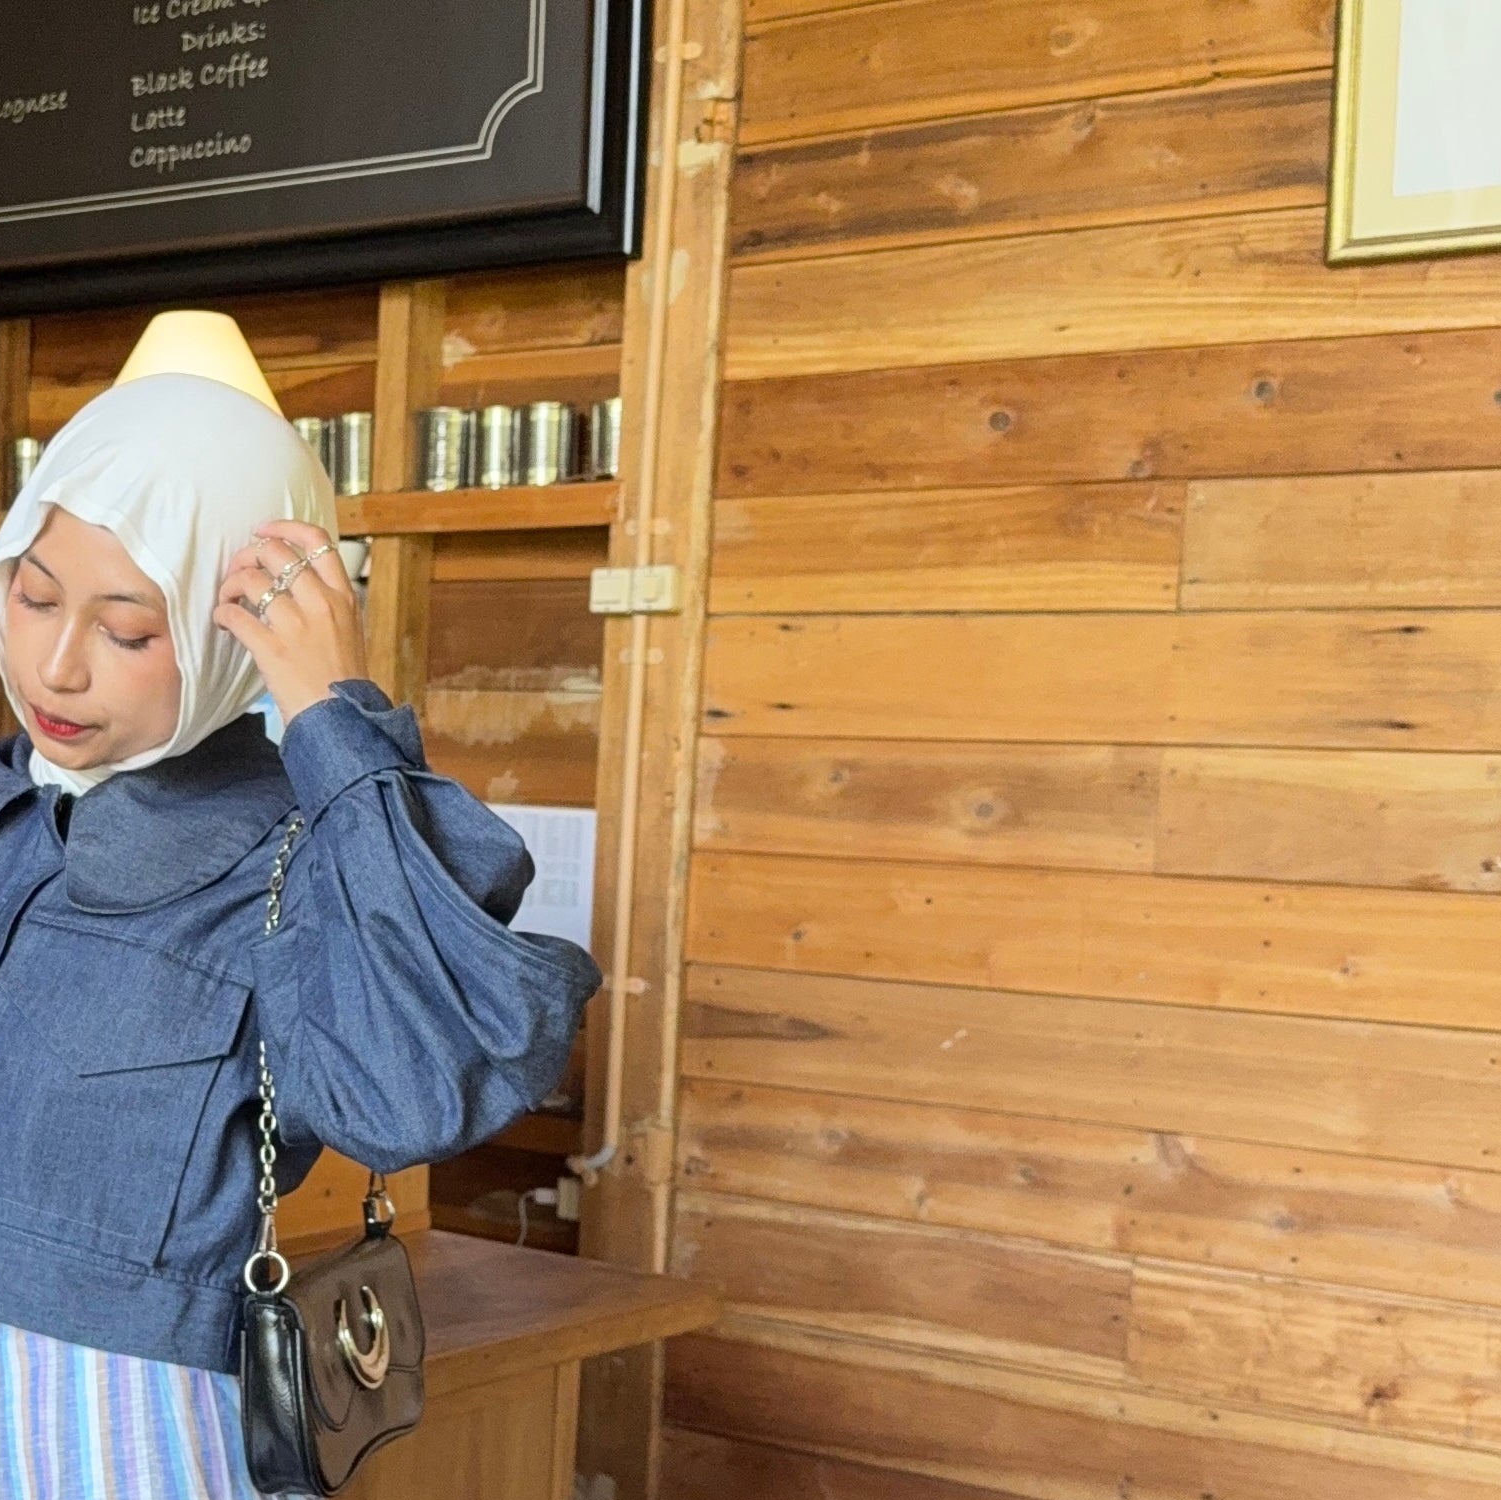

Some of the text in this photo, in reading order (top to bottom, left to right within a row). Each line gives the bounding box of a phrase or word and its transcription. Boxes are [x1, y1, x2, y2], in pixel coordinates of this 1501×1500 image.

[133, 3, 160, 24] Ice
[181, 21, 267, 51] Drinks:
[130, 52, 269, 97] Black Coffee
[130, 106, 186, 132] Latte
[129, 132, 252, 173] Cappuccino
